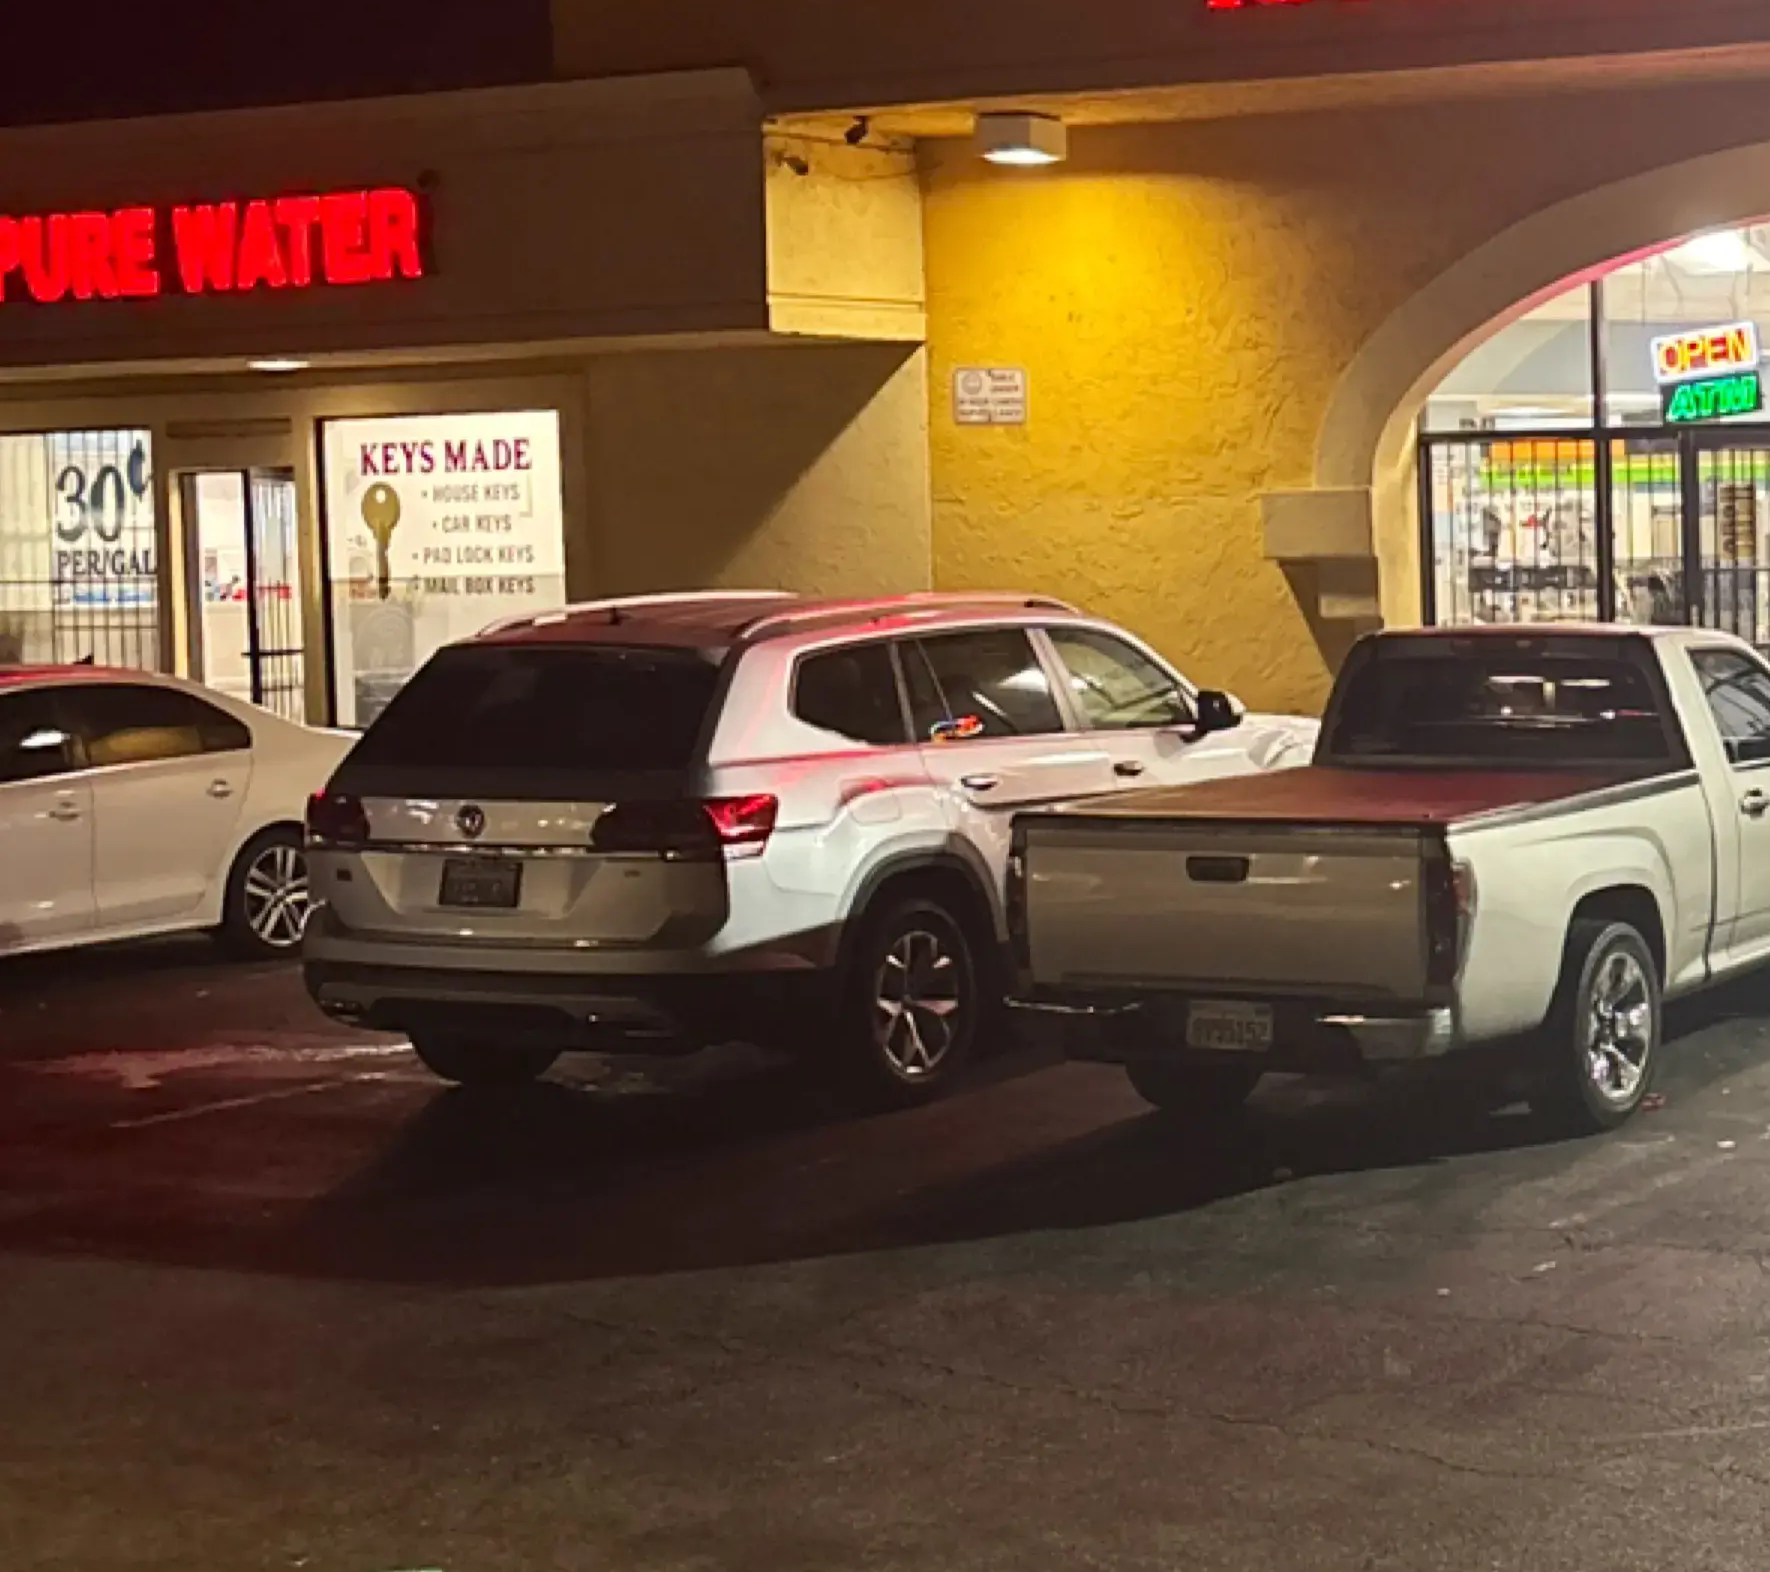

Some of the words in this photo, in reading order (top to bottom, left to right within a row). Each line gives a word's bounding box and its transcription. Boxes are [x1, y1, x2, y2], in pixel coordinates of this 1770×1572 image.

[172, 187, 422, 294] WATER
[1658, 329, 1751, 375] OPEN
[1666, 375, 1756, 422] ATM
[360, 440, 435, 476] KEYS
[444, 436, 533, 472] MADE
[432, 484, 479, 502] HOUSE
[484, 483, 520, 500] KEYS
[442, 514, 470, 533] CAR
[475, 513, 512, 532] KEYS
[424, 546, 451, 564] PAD
[456, 545, 493, 563] LOCK
[499, 544, 534, 563] KEYS
[466, 576, 493, 595] BOX
[499, 575, 535, 594] KEYS
